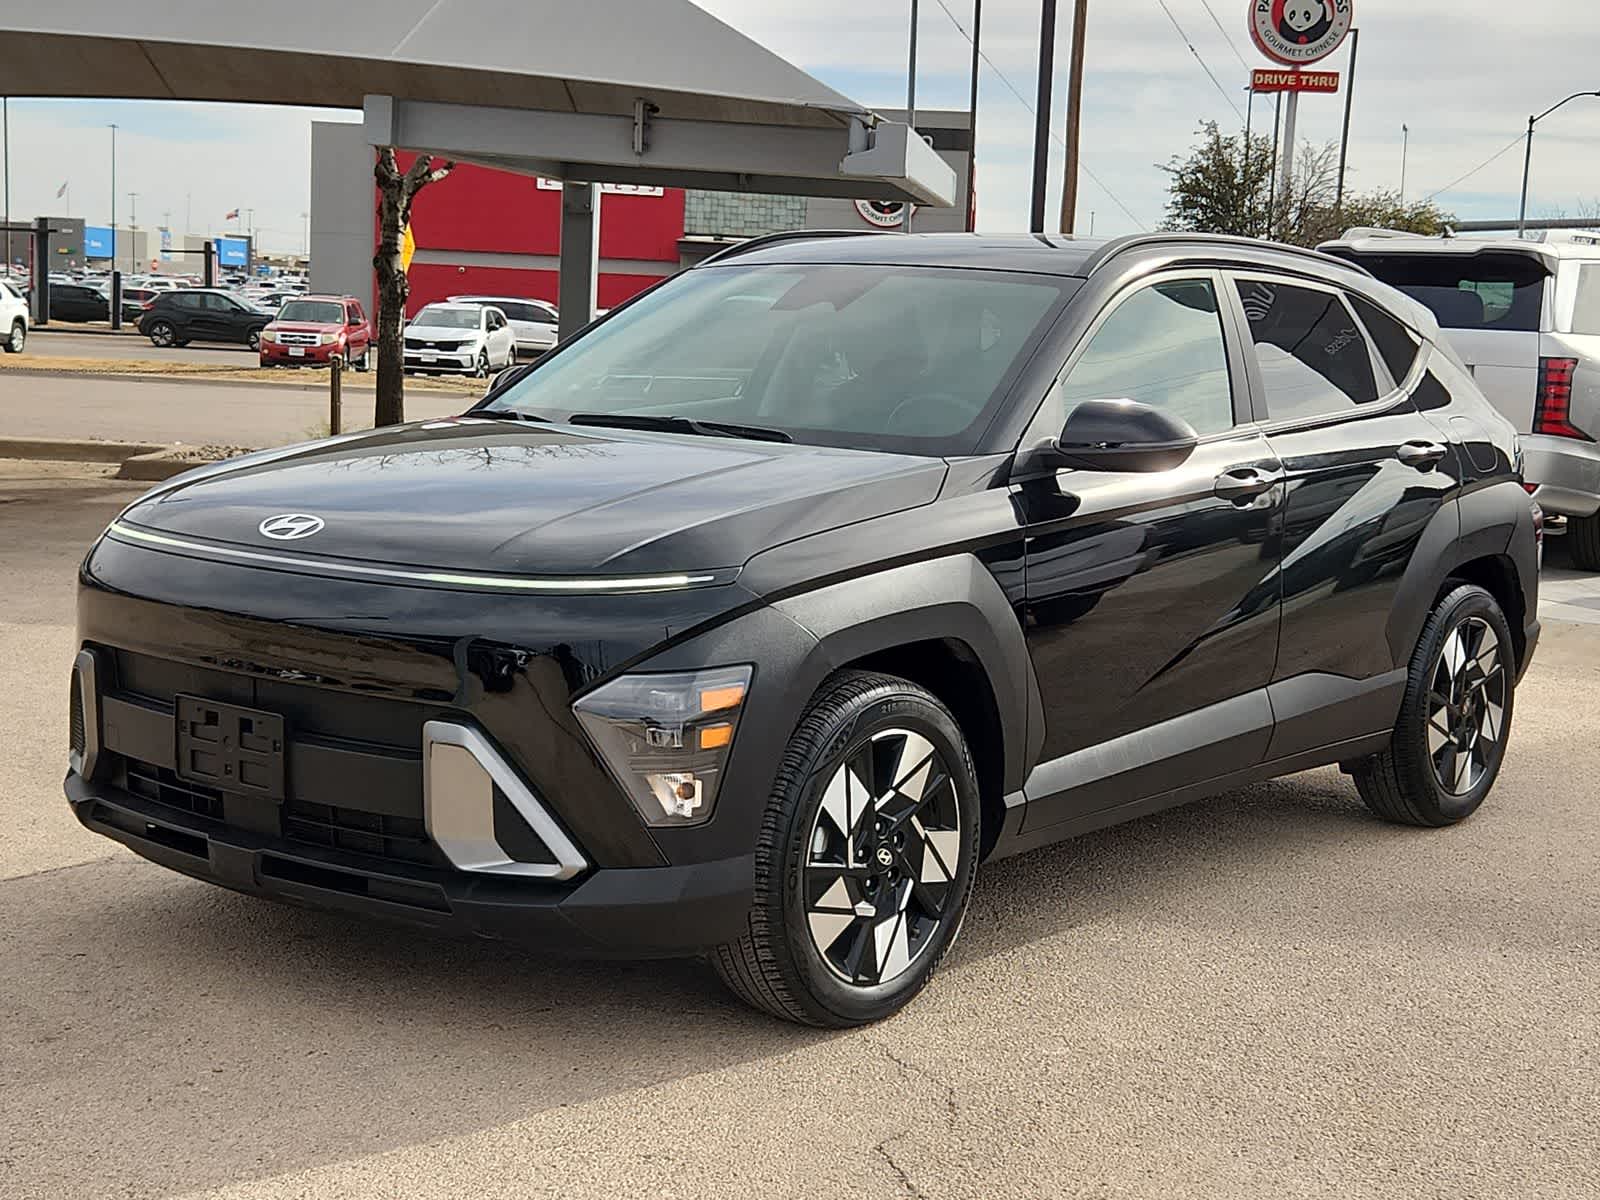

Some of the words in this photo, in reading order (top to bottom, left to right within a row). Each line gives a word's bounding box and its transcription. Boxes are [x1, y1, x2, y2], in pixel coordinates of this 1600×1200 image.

[1263, 29, 1303, 56] GOURMET
[1306, 31, 1340, 56] CHINESE
[1254, 73, 1297, 85] DRIVE
[1299, 75, 1339, 87] THRU
